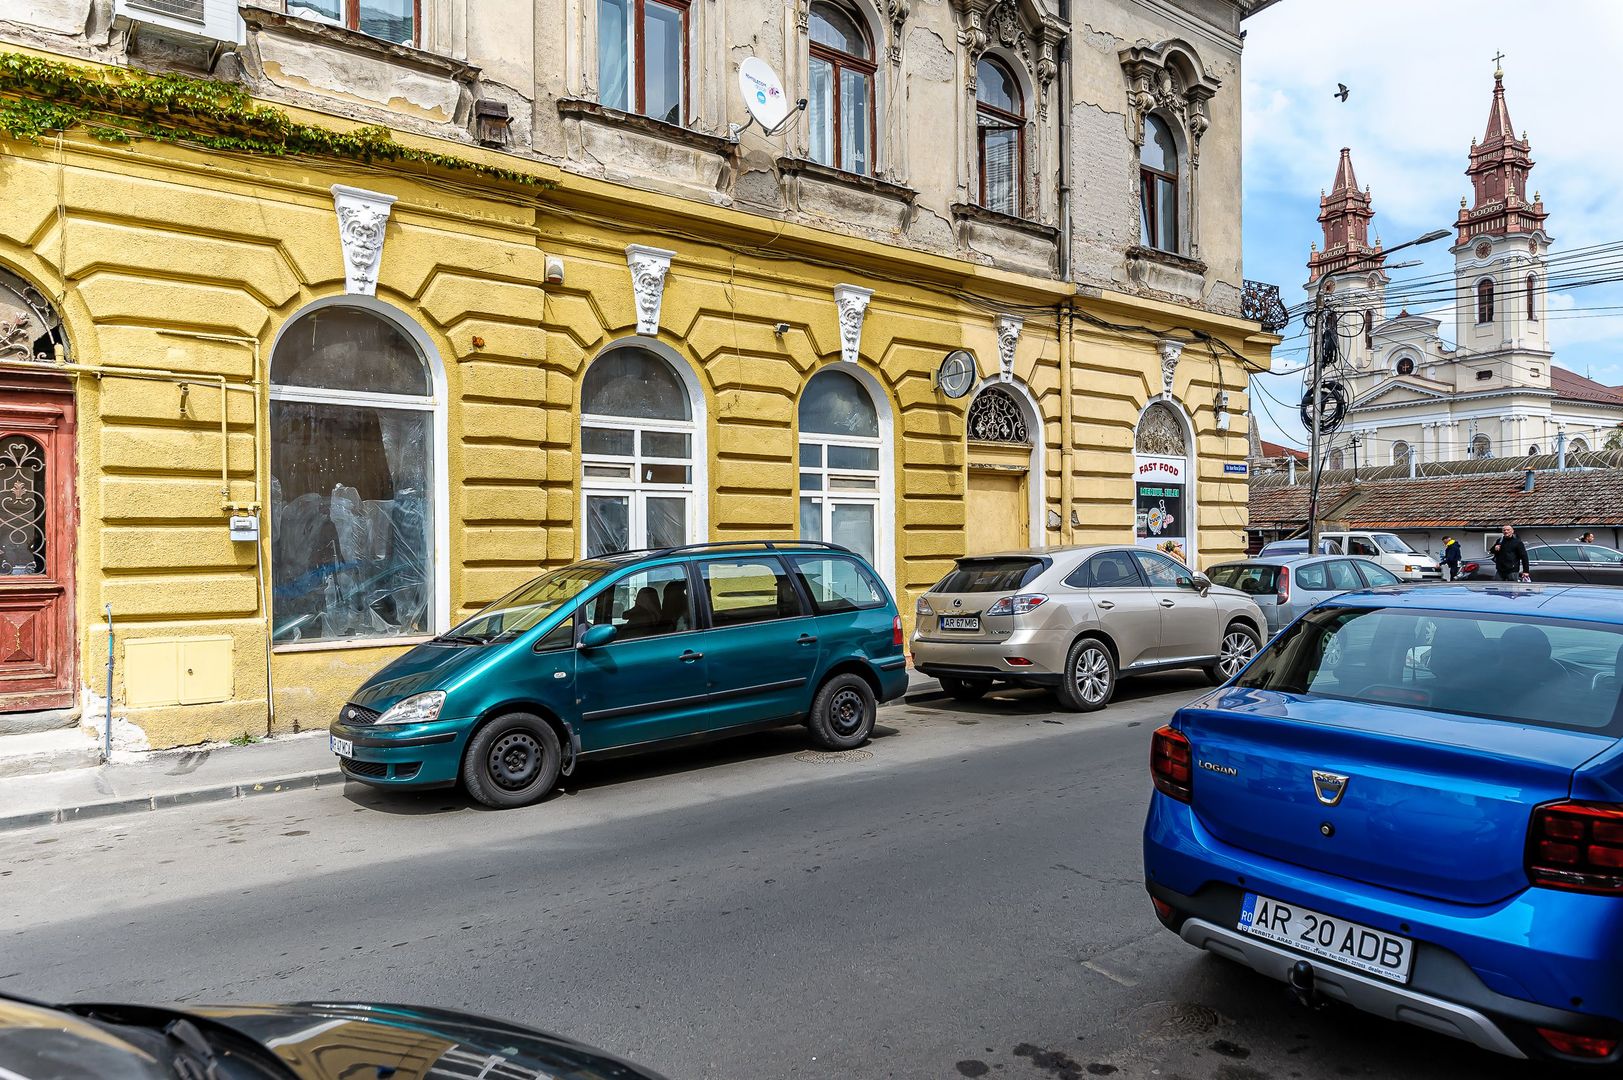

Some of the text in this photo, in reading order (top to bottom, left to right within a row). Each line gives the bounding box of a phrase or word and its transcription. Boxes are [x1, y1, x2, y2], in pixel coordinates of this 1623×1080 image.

[1140, 462, 1178, 476] FAST FOOD
[945, 619, 977, 628] AR 67 MIG
[1198, 759, 1238, 776] LOGAN
[1241, 910, 1253, 922] RO
[1256, 901, 1404, 968] AR 20 ADB
[1276, 936, 1292, 944] ARAD
